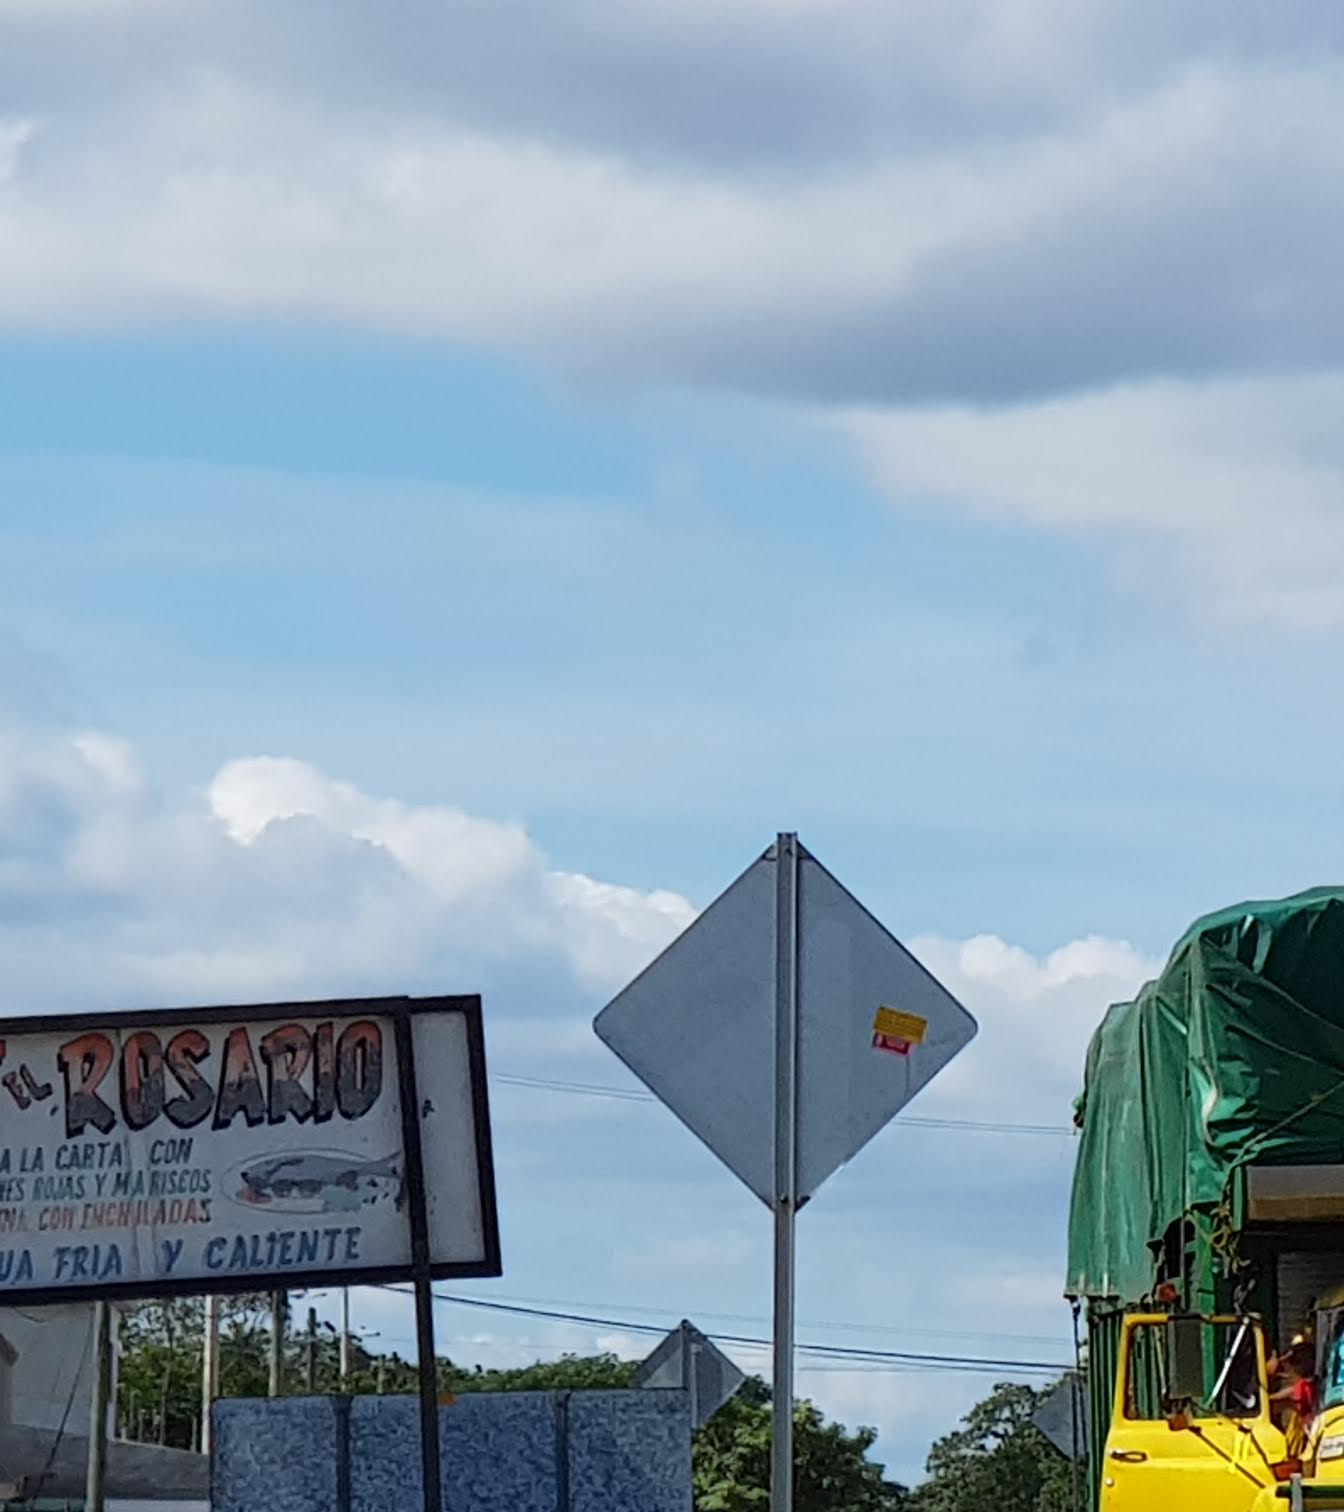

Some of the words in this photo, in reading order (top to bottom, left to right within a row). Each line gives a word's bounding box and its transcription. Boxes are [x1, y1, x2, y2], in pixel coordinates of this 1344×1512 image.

[57, 1021, 383, 1139] ROSARIO
[19, 1146, 45, 1173] LA
[55, 1141, 123, 1171] CARTA
[148, 1136, 194, 1166] CON
[95, 1172, 108, 1198] Y
[54, 1243, 123, 1281] FRIA
[161, 1238, 185, 1273] Y
[205, 1226, 362, 1271] CALIENTE
